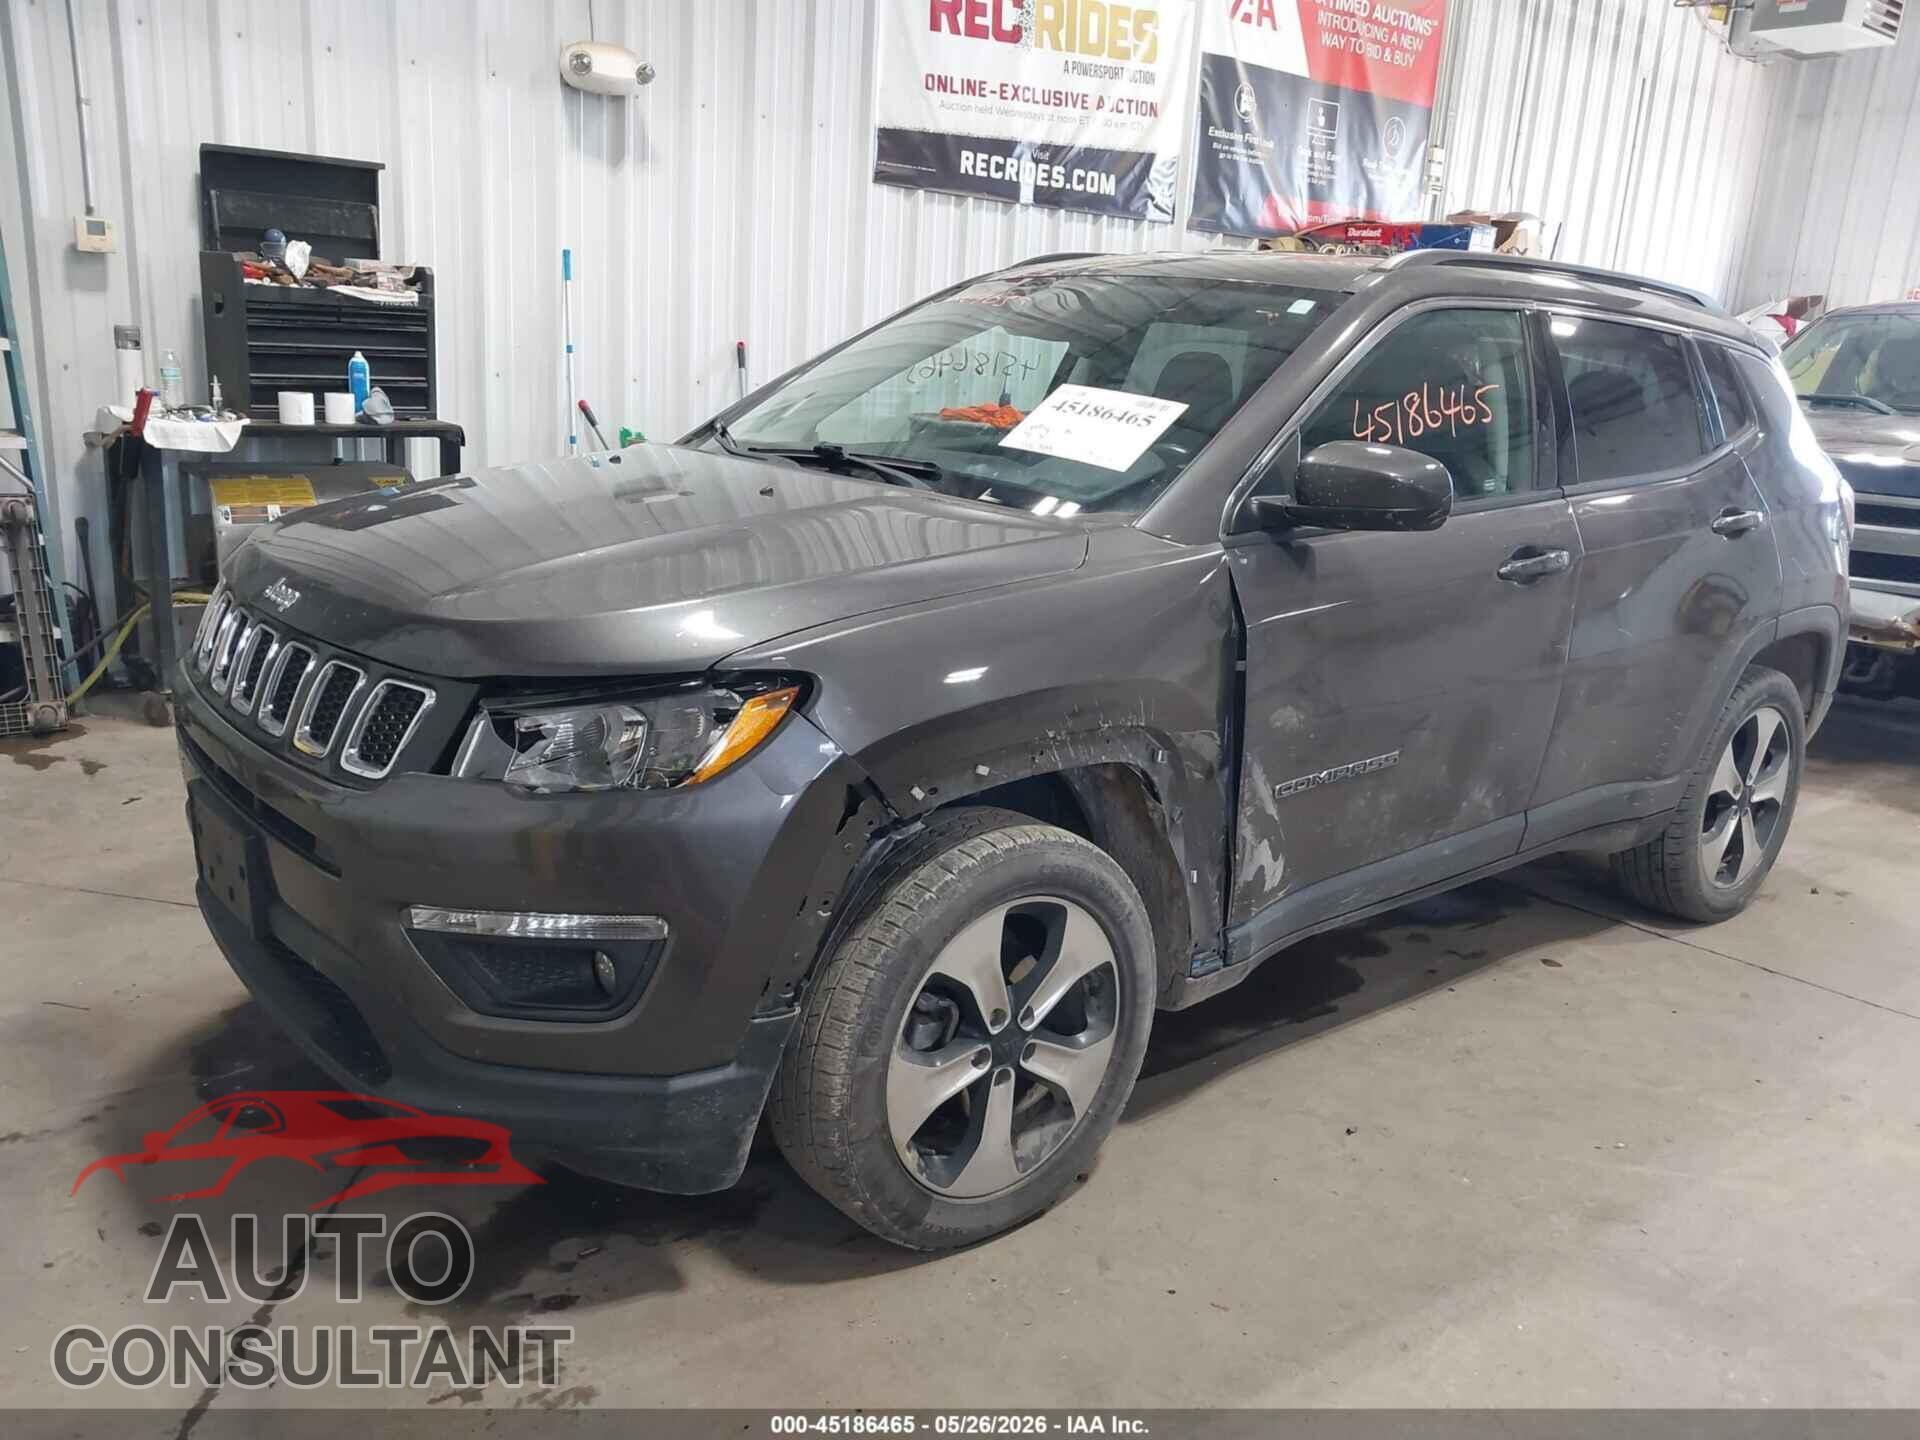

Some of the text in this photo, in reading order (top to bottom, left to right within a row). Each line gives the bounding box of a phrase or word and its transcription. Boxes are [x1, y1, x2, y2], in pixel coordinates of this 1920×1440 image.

[1033, 0, 1159, 64] RIDES
[1317, 10, 1424, 52] INTRODUCING A NEW
[1321, 30, 1416, 68] WAY TO BID & BUY
[1063, 60, 1070, 75] A
[1072, 61, 1124, 80] POWERSPORT
[925, 73, 1159, 118] ONLINE-EXCLUSIVE ACTION
[1031, 149, 1050, 161] Visit
[1051, 400, 1156, 428] 45186465
[1353, 382, 1500, 444] 45186465
